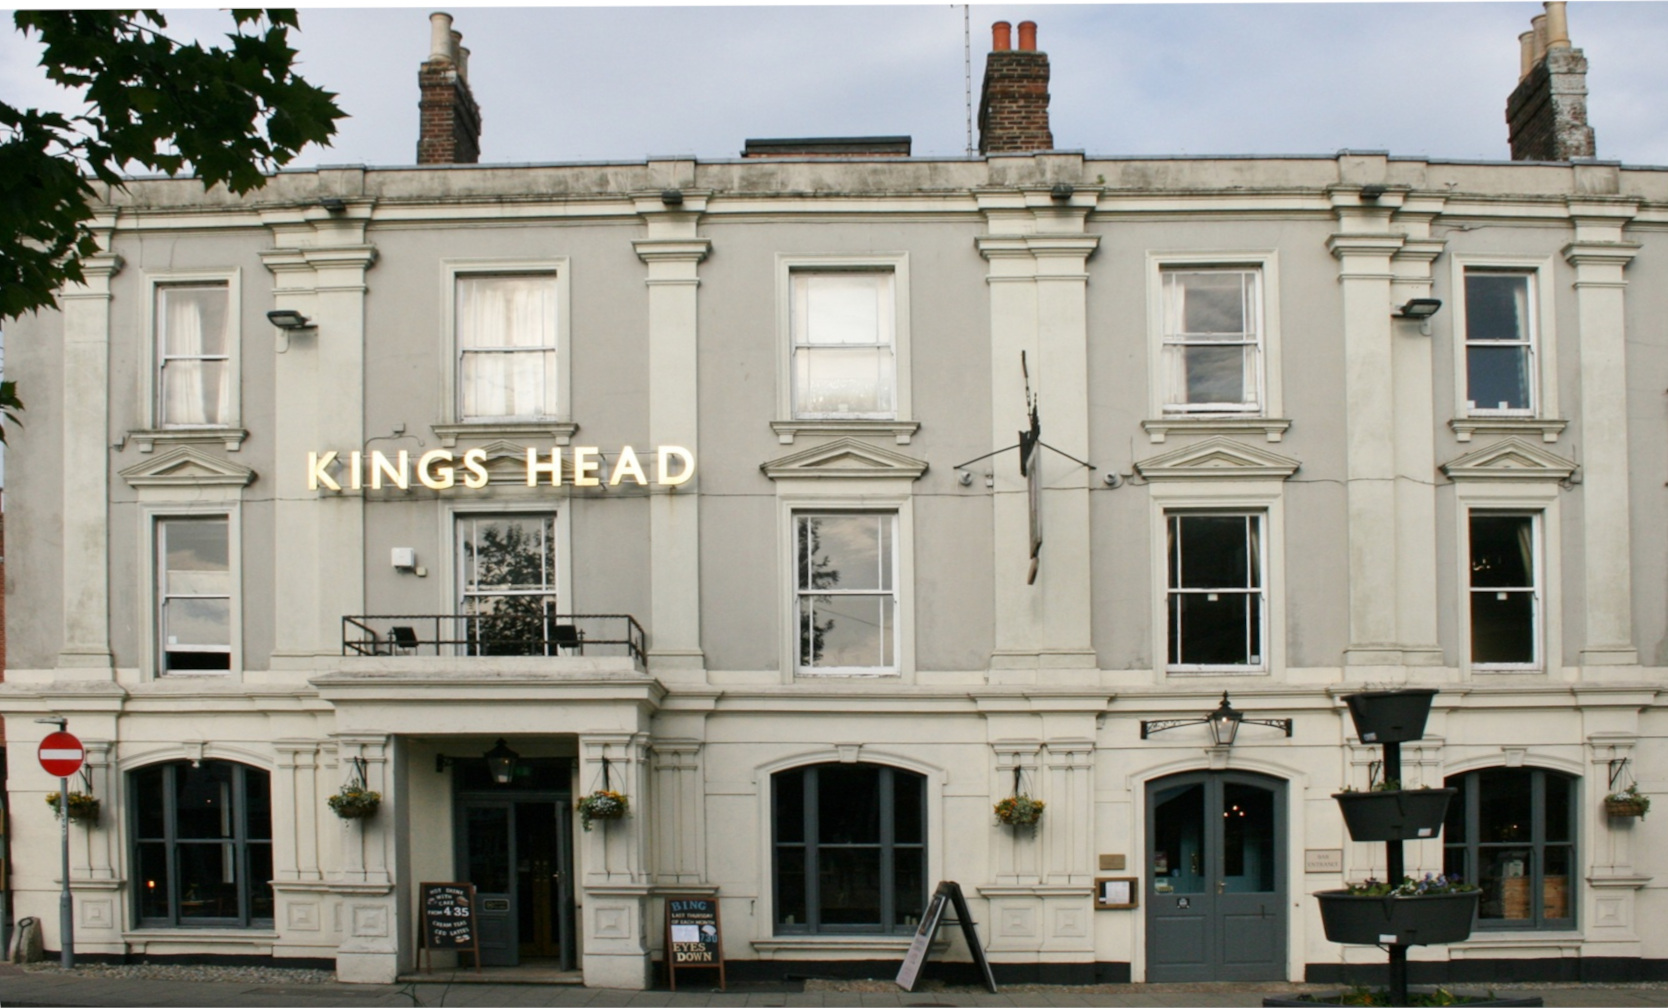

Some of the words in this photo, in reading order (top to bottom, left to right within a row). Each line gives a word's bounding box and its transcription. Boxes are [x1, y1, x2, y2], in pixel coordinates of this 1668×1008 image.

[307, 448, 490, 491] KINGS
[526, 445, 696, 487] HEAD
[673, 942, 706, 952] EYES
[676, 952, 712, 962] DOWN
